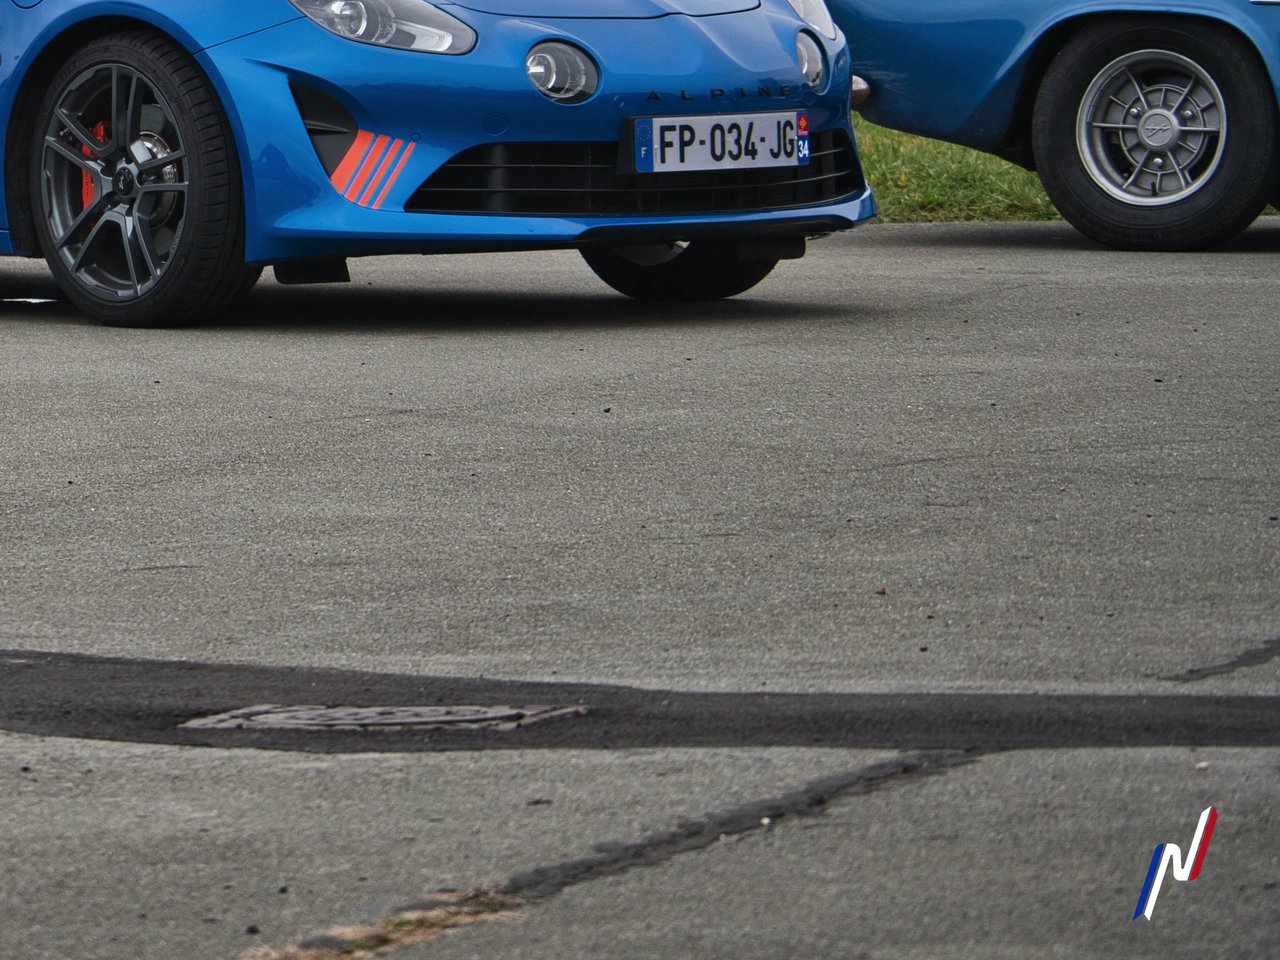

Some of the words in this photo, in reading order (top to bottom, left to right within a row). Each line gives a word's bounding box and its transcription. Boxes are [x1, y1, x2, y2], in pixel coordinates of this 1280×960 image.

[647, 86, 790, 101] ALPINE
[659, 119, 795, 165] FP-034-JG
[798, 139, 809, 158] 34
